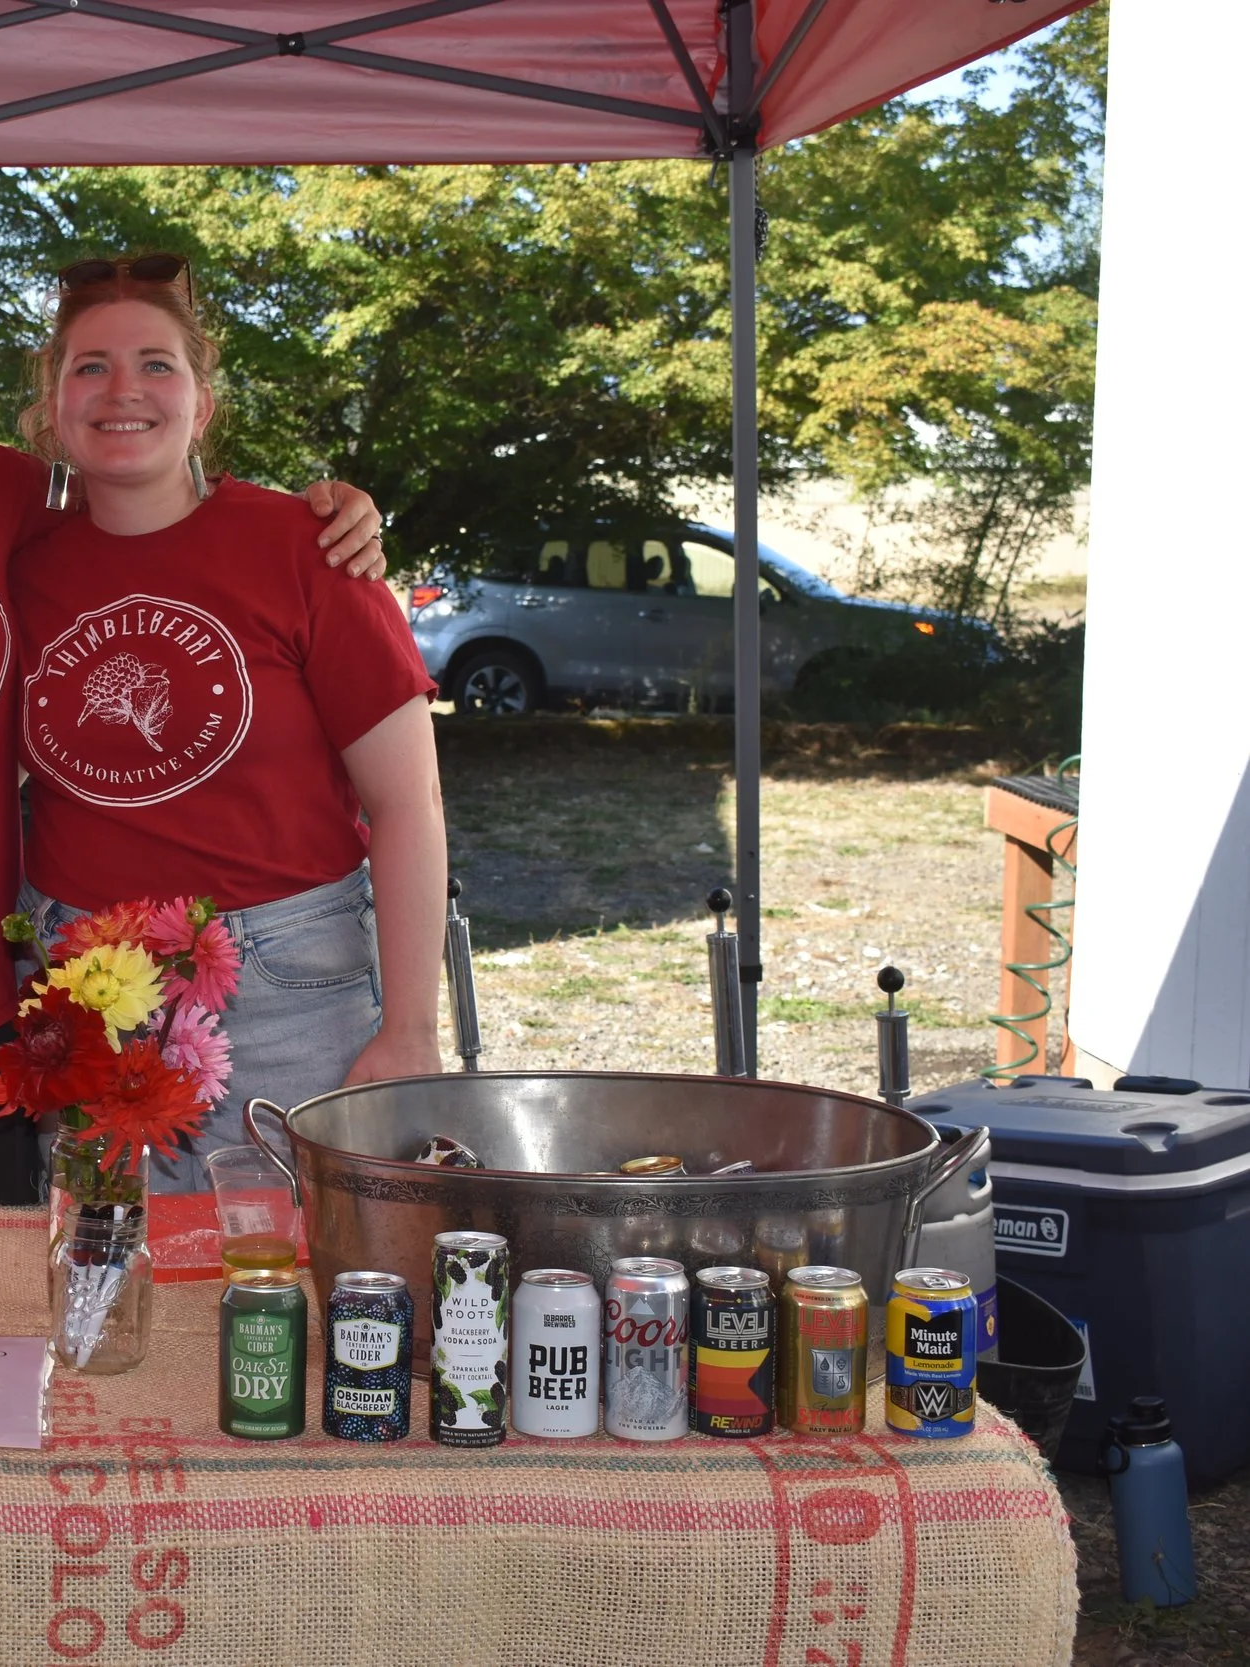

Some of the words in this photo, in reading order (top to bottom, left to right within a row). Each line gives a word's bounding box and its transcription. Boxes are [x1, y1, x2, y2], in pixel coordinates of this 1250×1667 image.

[47, 608, 223, 678] THIMBLEBERRY
[39, 722, 182, 784] COLLABORATIVE
[185, 712, 224, 760] FARM
[452, 1297, 489, 1307] WILD
[446, 1309, 494, 1320] ROOTS
[551, 1314, 576, 1322] BARREL
[239, 1323, 283, 1335] BAUMAN'S
[706, 1310, 769, 1336] LEVEL
[340, 1329, 392, 1343] BAUMAN'S
[451, 1327, 490, 1336] BLACKBERRY
[910, 1328, 958, 1342] Minute
[247, 1341, 274, 1353] CIDER
[443, 1336, 469, 1345] VODKA
[477, 1336, 497, 1345] SODA
[718, 1340, 758, 1350] BEER
[349, 1349, 381, 1361] CIDER
[916, 1342, 952, 1355] Maid
[529, 1343, 588, 1376] PUB
[605, 1342, 684, 1372] LIGHT
[232, 1357, 264, 1373] OAK
[264, 1357, 288, 1375] ST.
[913, 1360, 955, 1369] Lemonade
[448, 1372, 466, 1380] CRAFT
[467, 1373, 493, 1381] COCKTAIL
[233, 1373, 288, 1400] DRY
[528, 1374, 587, 1401] BEER
[336, 1389, 392, 1403] OBSIDIAN
[336, 1400, 391, 1412] BLACKBERRY
[710, 1415, 763, 1429] REWIND
[47, 1463, 111, 1667] COLO
